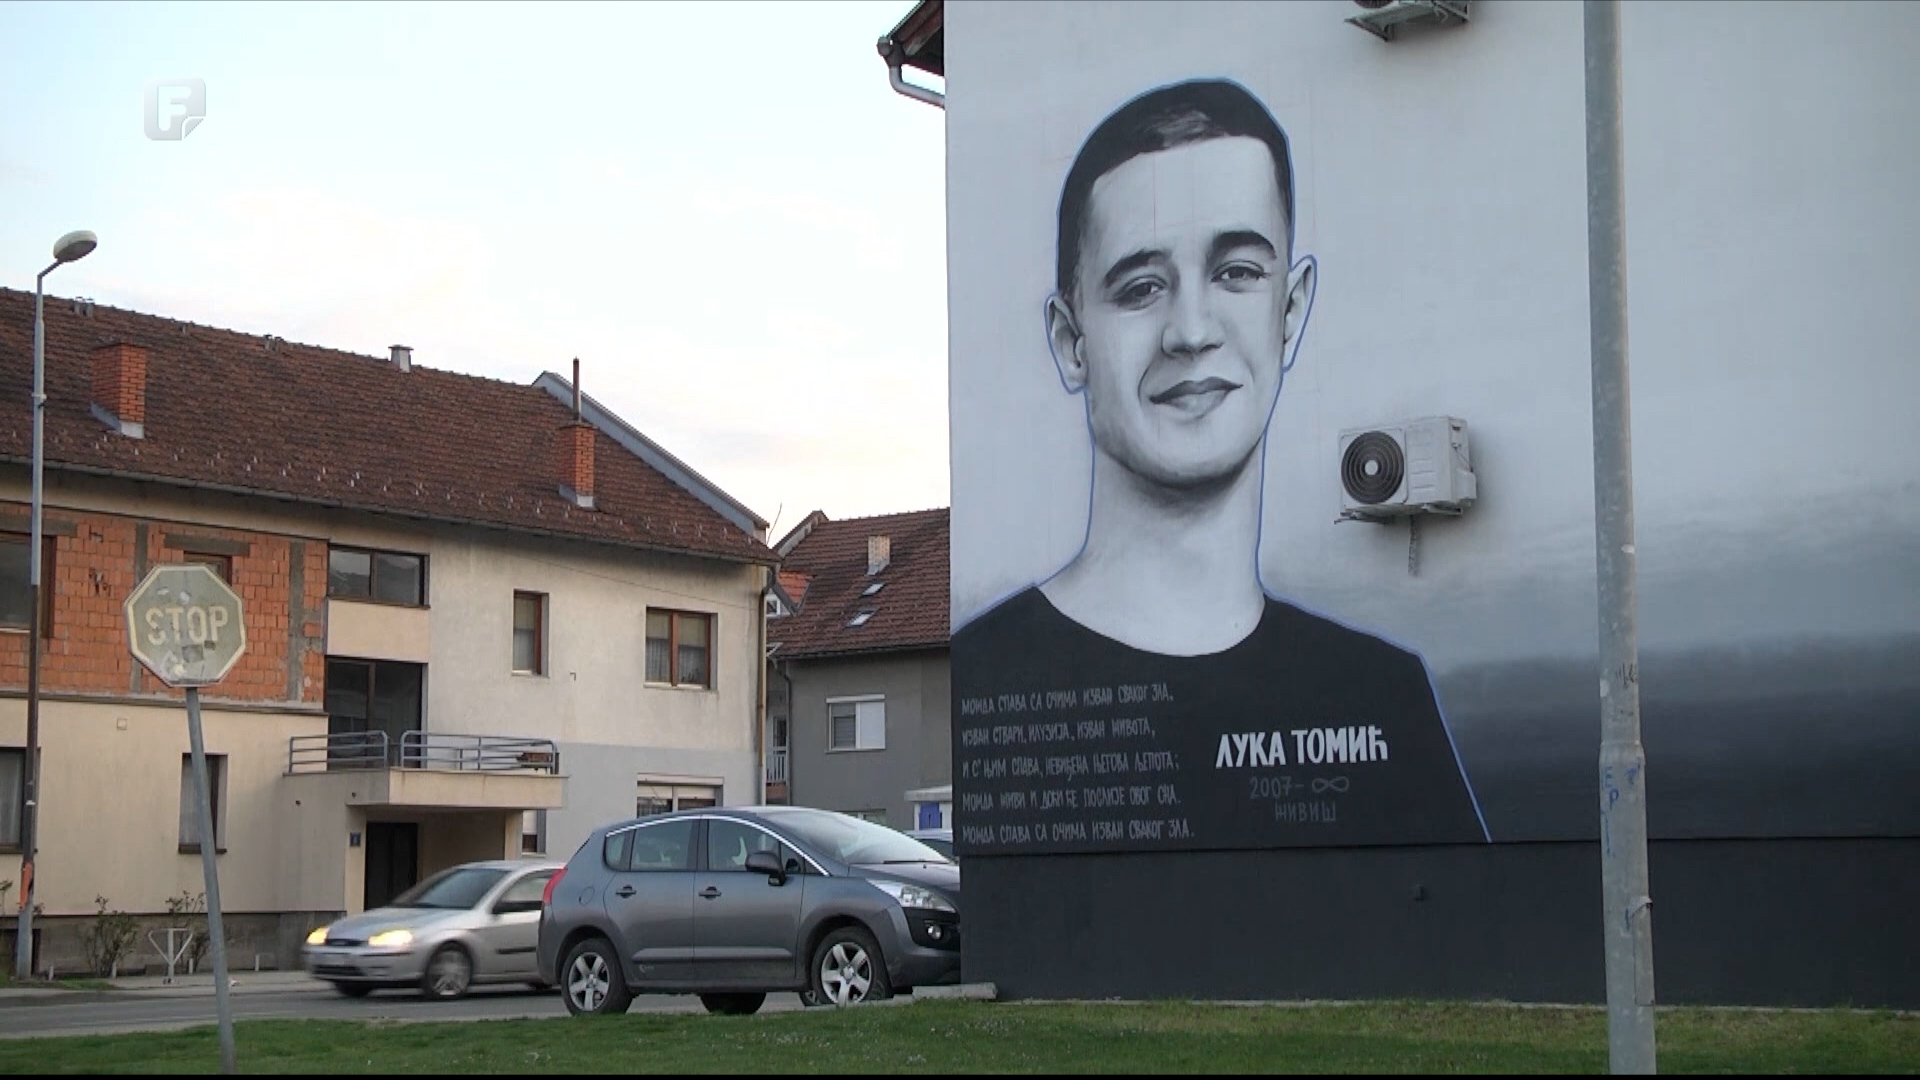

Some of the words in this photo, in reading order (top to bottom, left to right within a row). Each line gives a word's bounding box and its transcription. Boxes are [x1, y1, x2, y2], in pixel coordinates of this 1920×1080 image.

[145, 605, 229, 646] STOP
[998, 694, 1027, 712] СПАВА
[1030, 692, 1043, 711] СА
[1046, 690, 1077, 709] ОЧИМА
[1083, 687, 1113, 706] ИЗВАН
[1118, 684, 1149, 703] СВАКОГ
[962, 727, 990, 747] ИЗВАН
[1077, 720, 1105, 740] ИЗВАН
[1215, 731, 1287, 769] ЛУКА
[1291, 724, 1389, 765] ТОМИЋ
[1030, 789, 1038, 808] И
[1273, 801, 1337, 822] ЖИВИШ
[1000, 824, 1031, 844] СПАВА
[1034, 823, 1048, 842] СА
[1052, 821, 1087, 842] ОЧИМА
[1092, 820, 1124, 841] ИЗВАН
[1128, 820, 1165, 839] СВАКОГ
